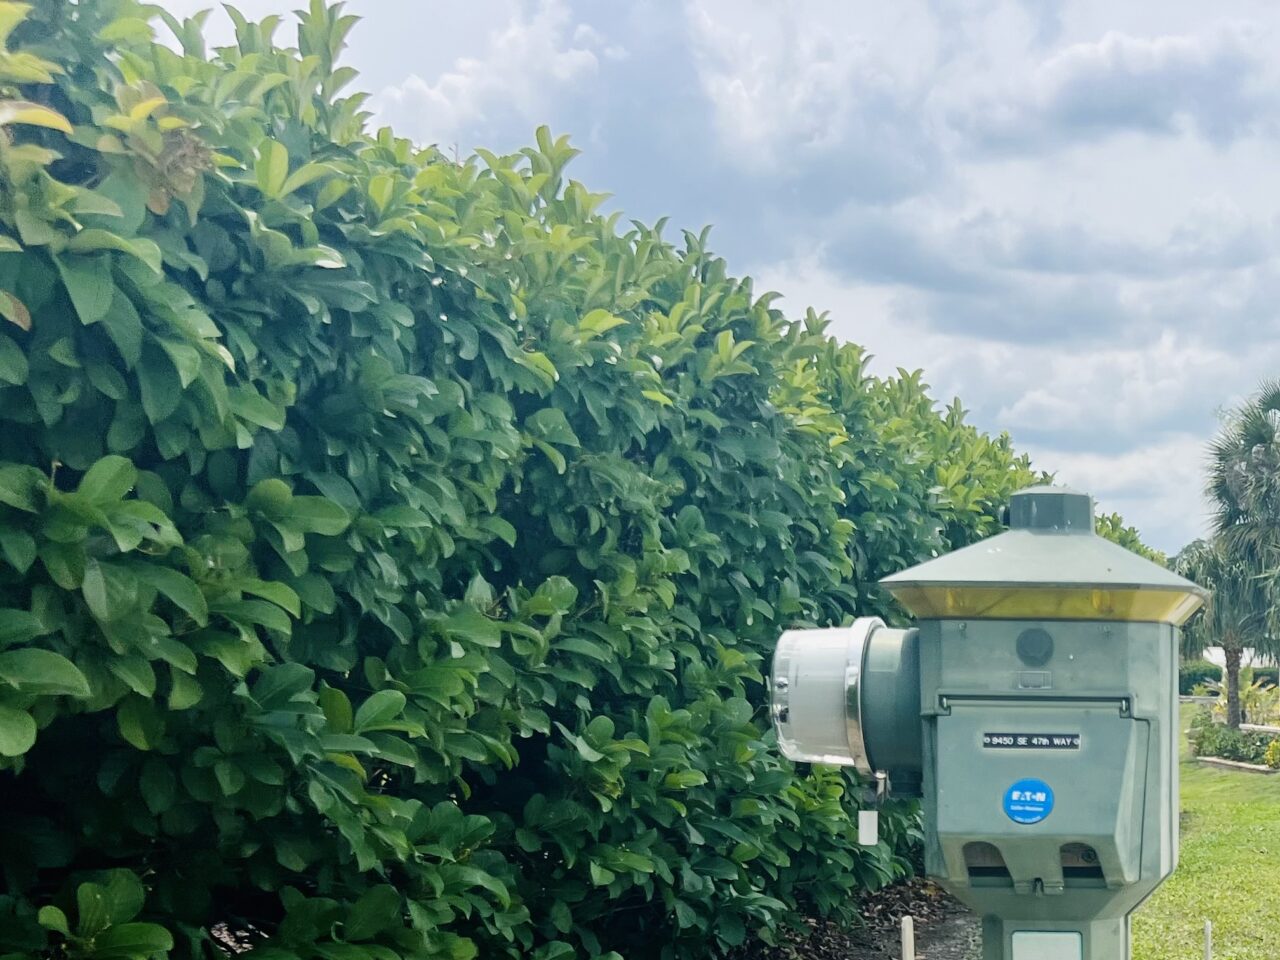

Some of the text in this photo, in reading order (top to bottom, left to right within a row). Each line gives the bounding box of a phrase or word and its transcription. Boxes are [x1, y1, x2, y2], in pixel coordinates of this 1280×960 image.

[992, 737, 1072, 746] 9450 SE 47th WAY
